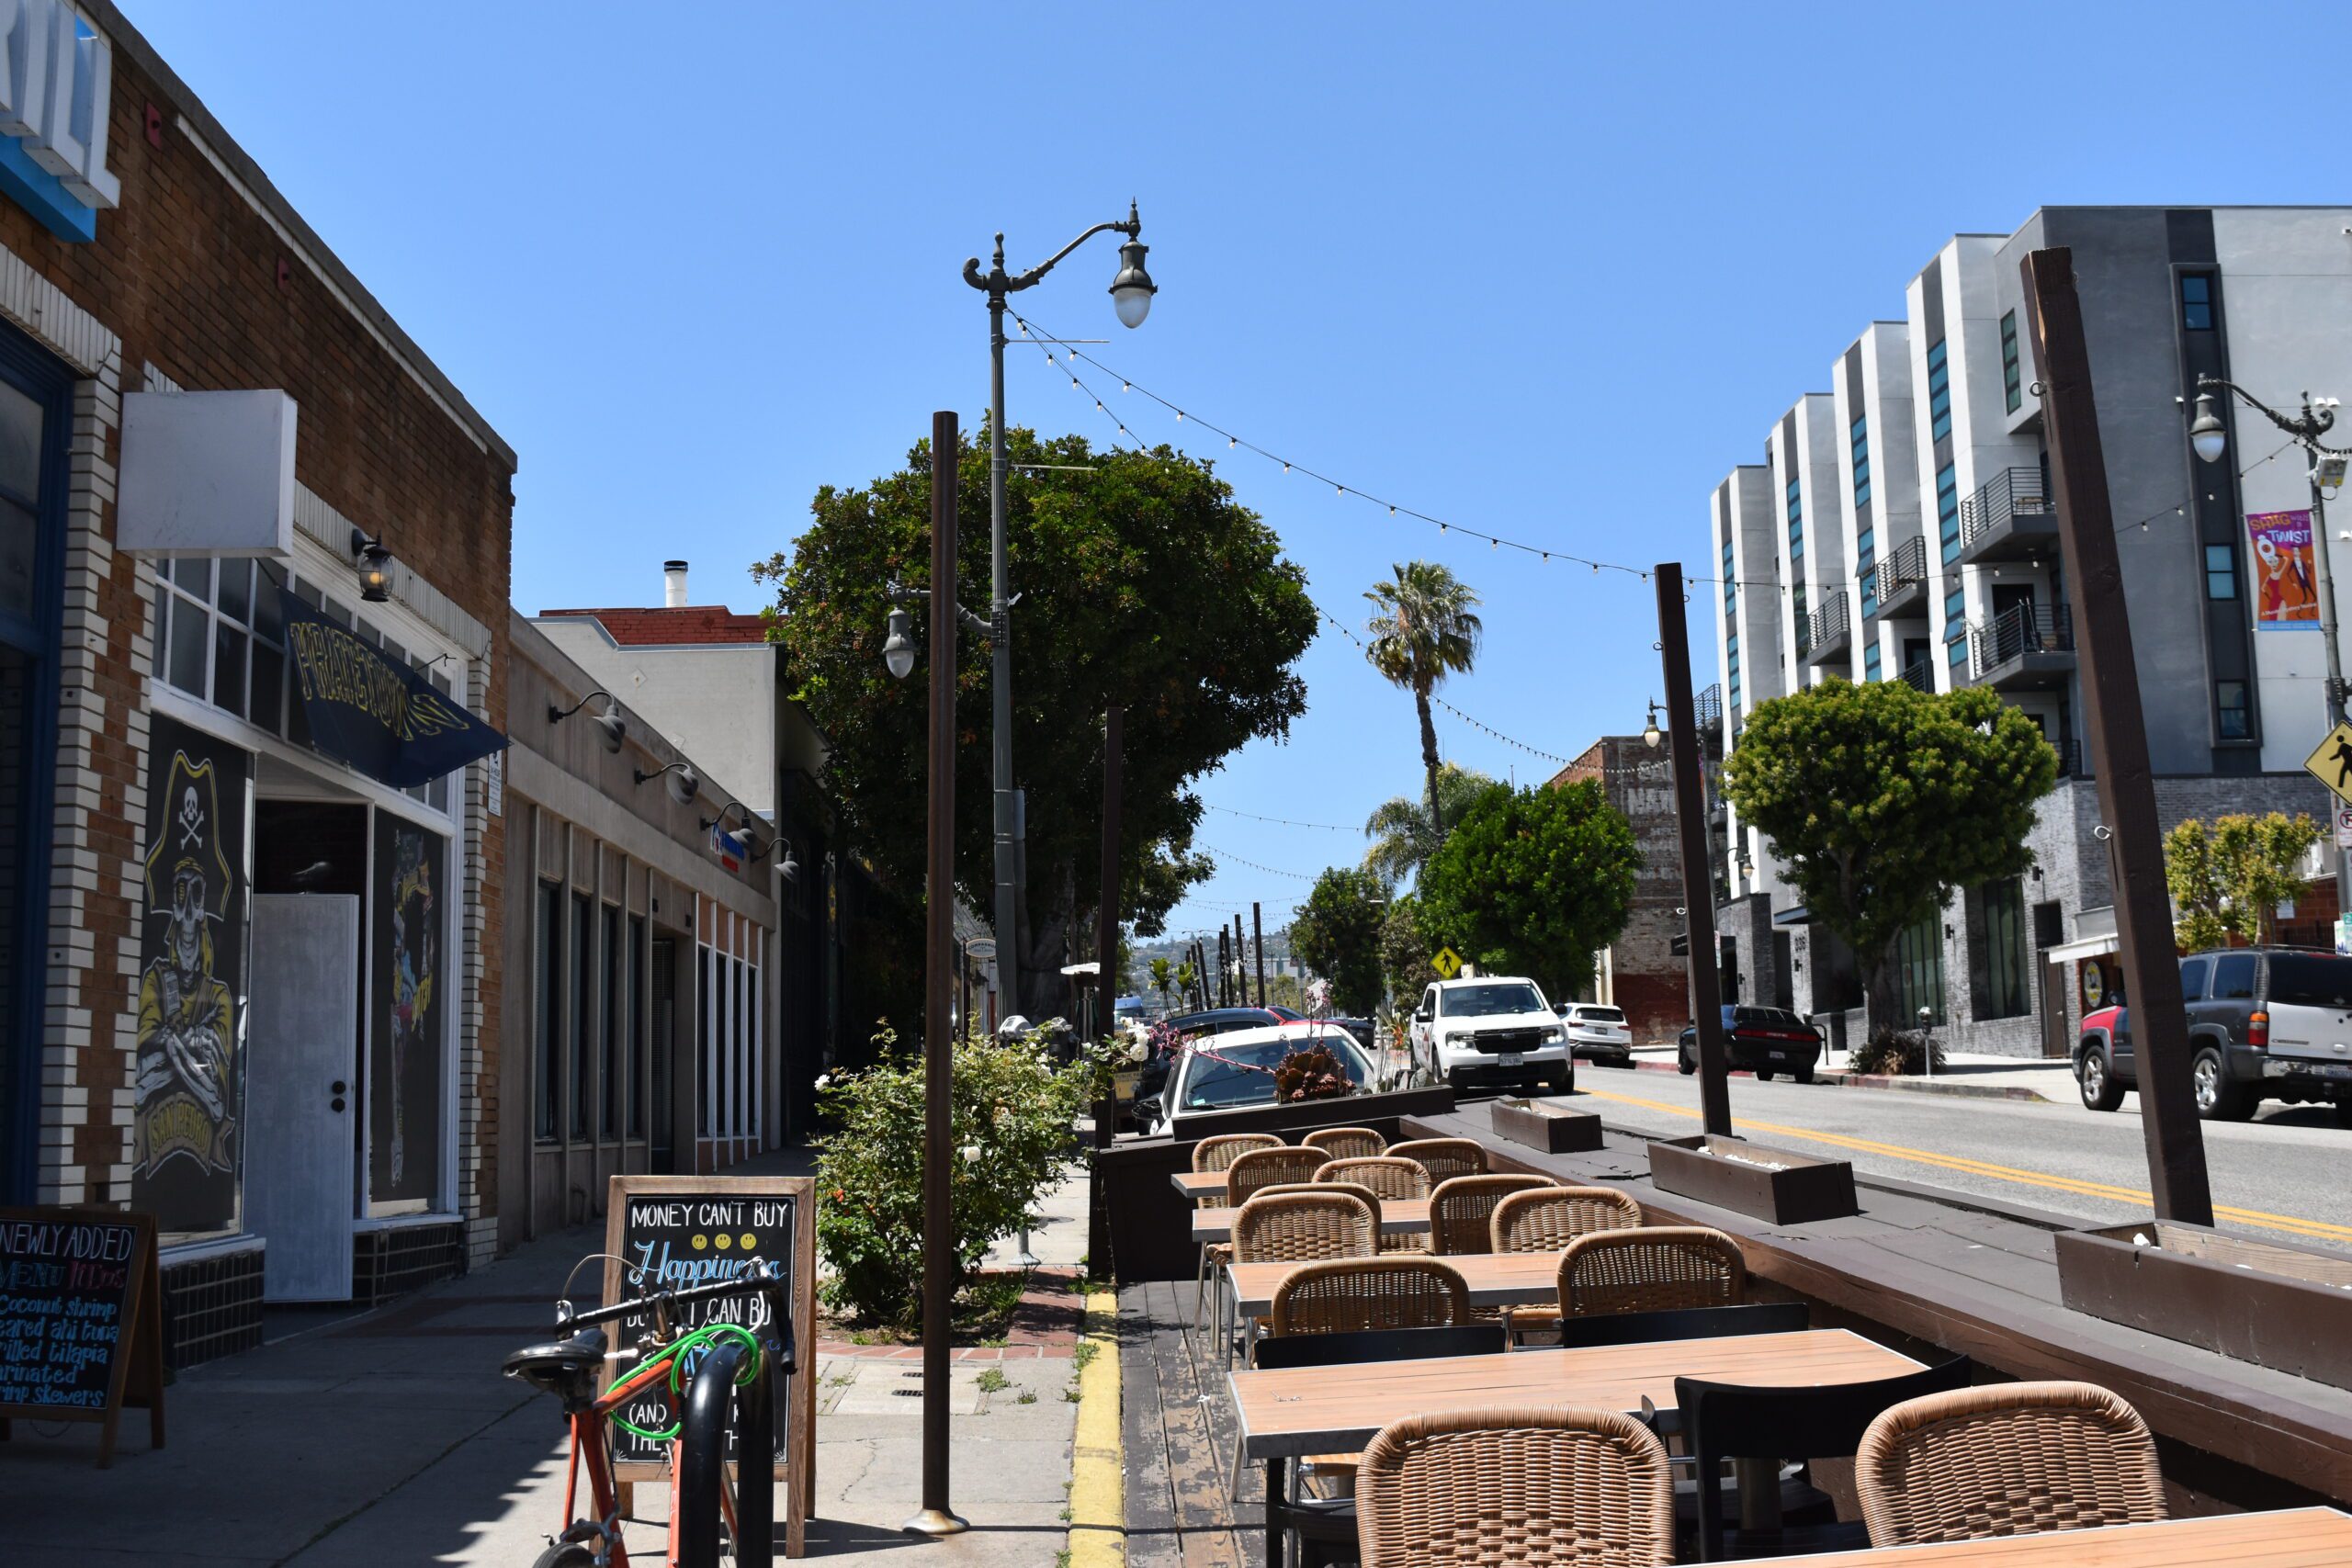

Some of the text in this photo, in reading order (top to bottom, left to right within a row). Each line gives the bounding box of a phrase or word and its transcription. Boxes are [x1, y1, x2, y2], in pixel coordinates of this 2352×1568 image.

[2249, 513, 2290, 531] SHAG
[2267, 529, 2310, 544] TWIST
[152, 1101, 209, 1154] SAN PEDRO
[631, 1201, 788, 1228] MONEY CAN'T BUY
[0, 1224, 132, 1261] NEWLY ADDED
[66, 1296, 118, 1322] shrimp
[707, 1298, 741, 1324] CAN
[51, 1318, 78, 1341] ahi
[82, 1320, 119, 1342] tuna
[49, 1341, 108, 1371] tilapia
[34, 1384, 104, 1407] skewers
